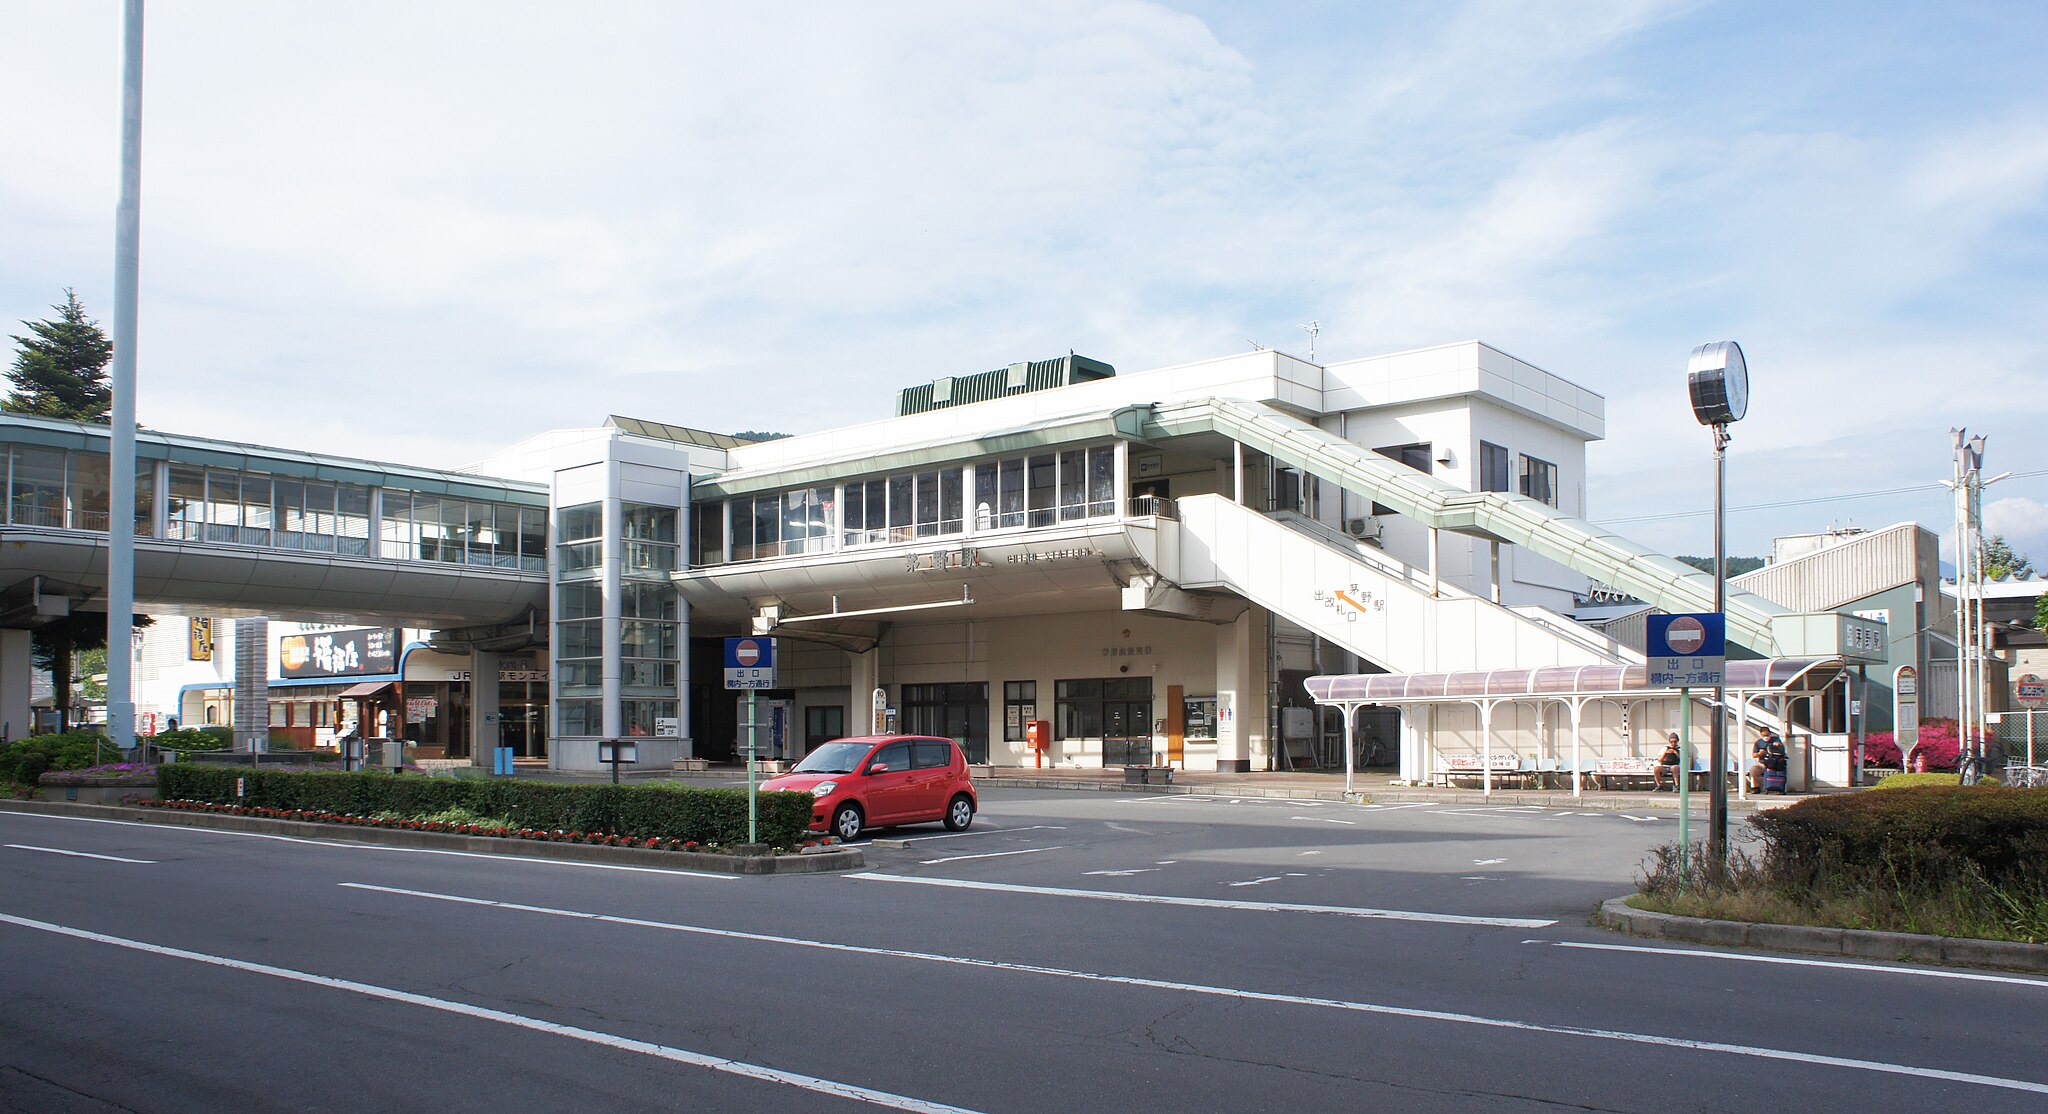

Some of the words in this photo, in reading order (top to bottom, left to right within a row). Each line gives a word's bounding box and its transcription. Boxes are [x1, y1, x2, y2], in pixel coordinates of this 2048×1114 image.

[1349, 583, 1384, 612] 茅野駅
[1314, 589, 1357, 622] 出改札口
[1667, 658, 1704, 670] 出口
[736, 669, 760, 678] 出口
[1650, 671, 1721, 684] 構内一方通行
[726, 679, 770, 688] 構内一方通行
